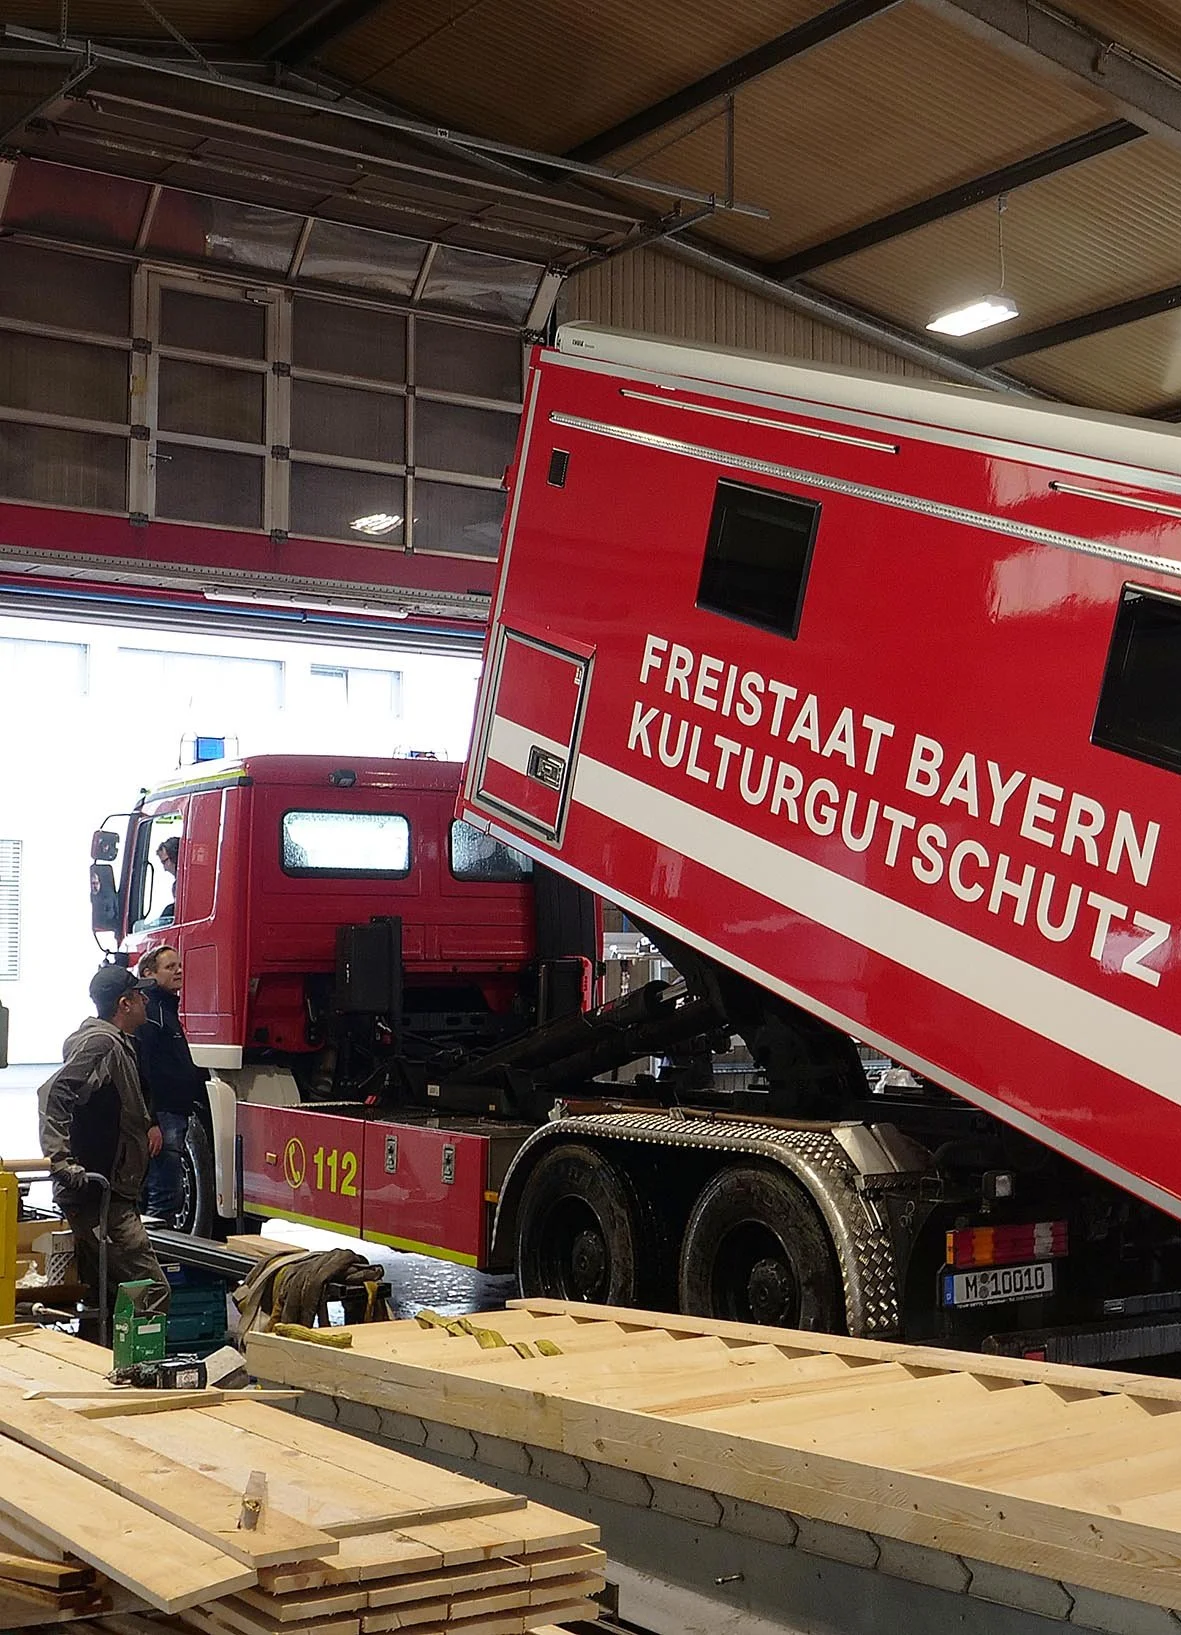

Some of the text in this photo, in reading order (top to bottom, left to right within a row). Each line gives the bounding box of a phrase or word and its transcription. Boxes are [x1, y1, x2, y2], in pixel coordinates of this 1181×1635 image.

[639, 633, 1160, 887] FREISTAAT BAYERN
[627, 701, 1172, 988] KULTURGUTSCHUTZ
[313, 1147, 359, 1197] 112
[965, 1267, 1045, 1300] M 10010
